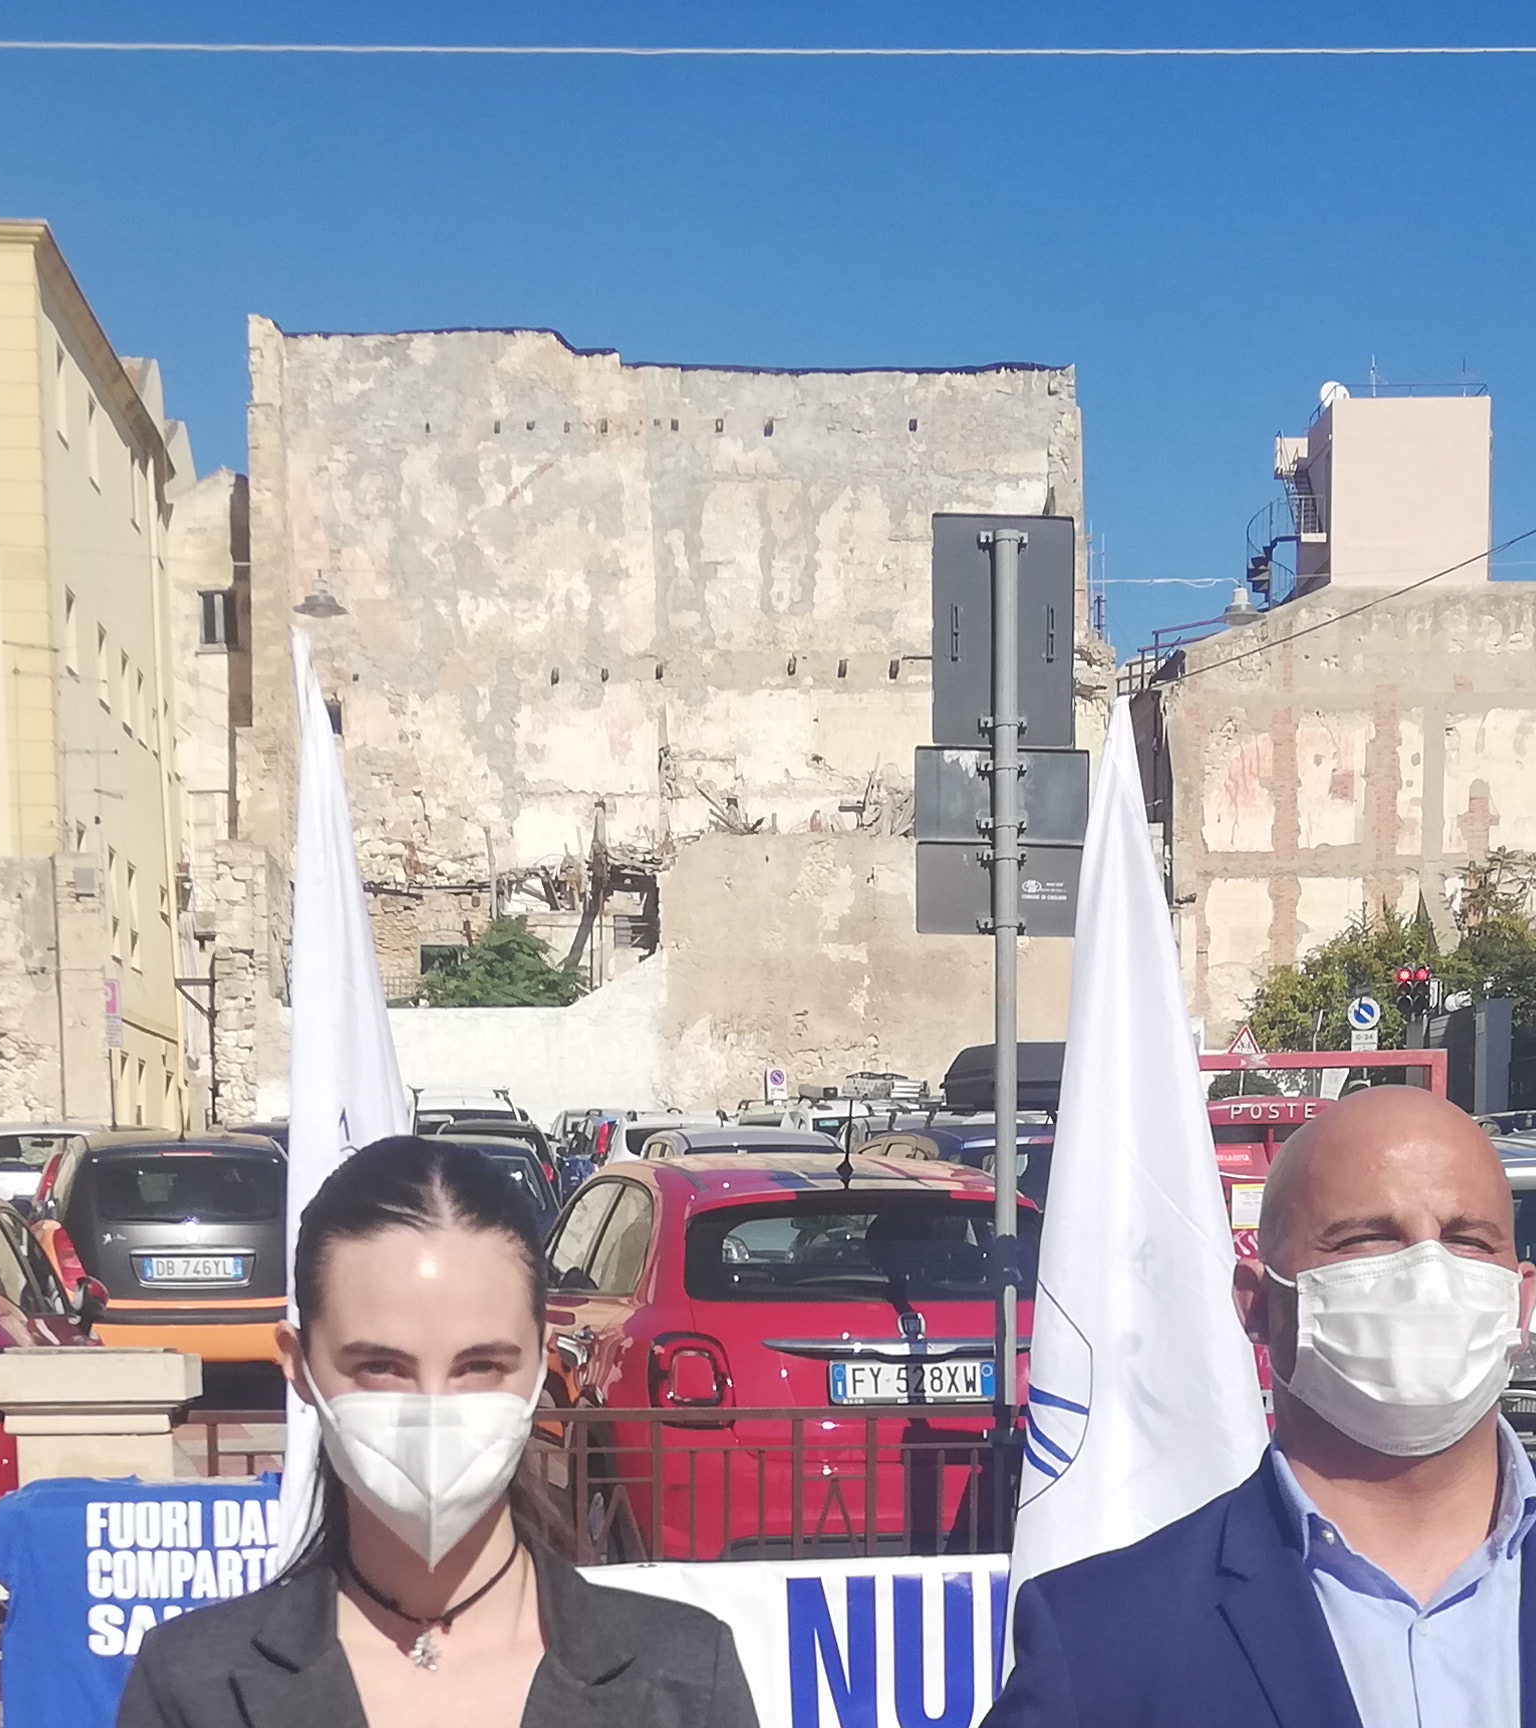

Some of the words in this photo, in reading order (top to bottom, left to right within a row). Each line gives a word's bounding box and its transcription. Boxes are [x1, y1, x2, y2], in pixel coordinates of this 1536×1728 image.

[1230, 1102, 1317, 1120] POSTE
[156, 1260, 175, 1276] DB
[183, 1260, 231, 1276] 746YL
[852, 1367, 882, 1394] FY
[896, 1365, 977, 1394] 528XW
[86, 1501, 202, 1548] FUORI
